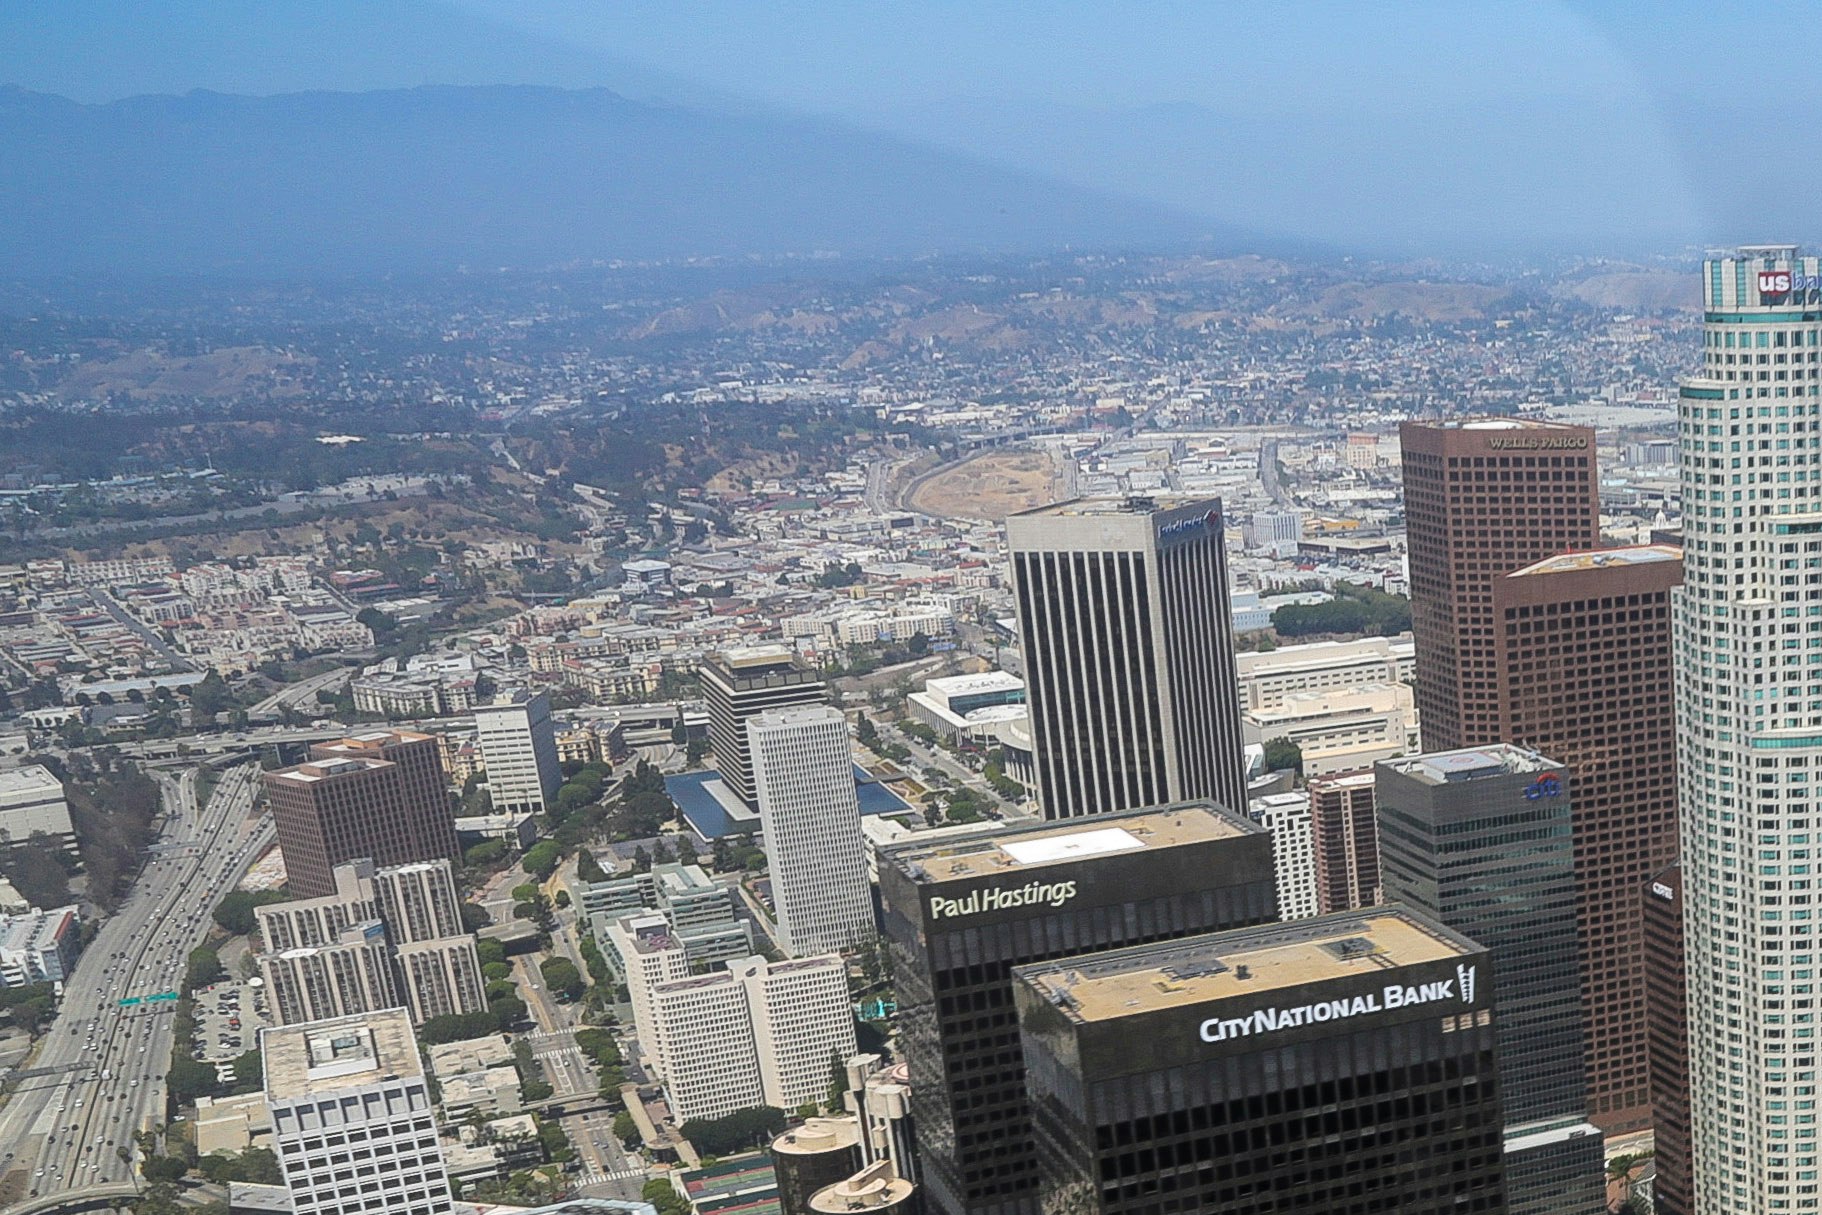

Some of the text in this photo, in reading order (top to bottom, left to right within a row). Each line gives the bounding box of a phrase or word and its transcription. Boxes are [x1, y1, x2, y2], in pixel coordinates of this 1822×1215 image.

[1760, 275, 1789, 292] us
[1490, 437, 1587, 448] WELLS FARGO
[930, 881, 1076, 919] Paul Hastings
